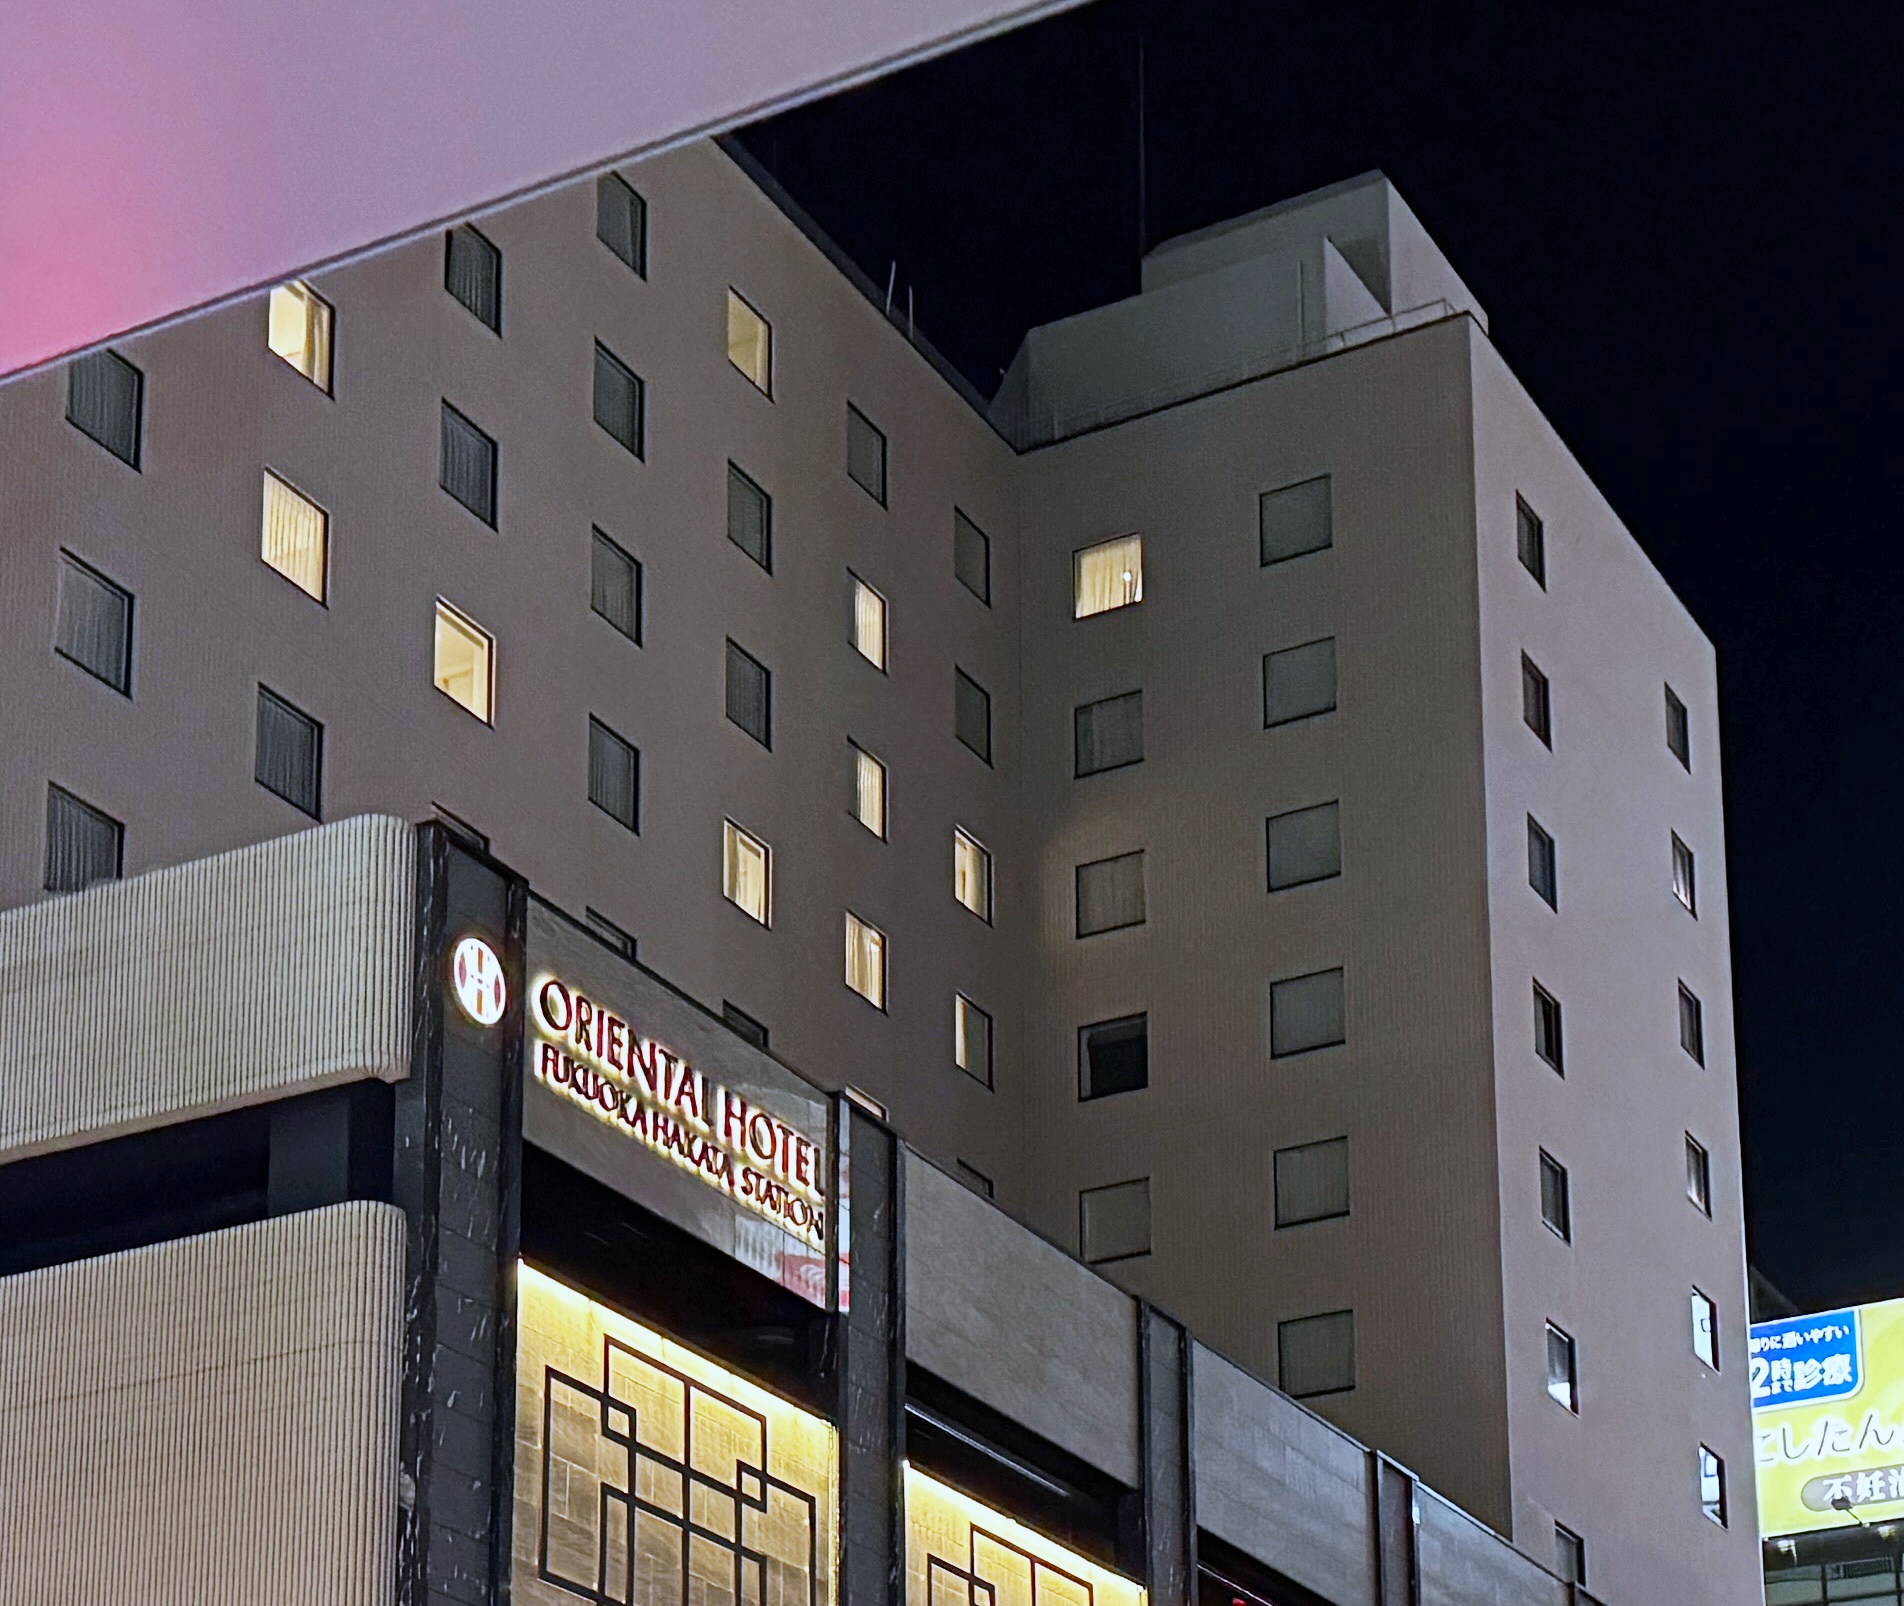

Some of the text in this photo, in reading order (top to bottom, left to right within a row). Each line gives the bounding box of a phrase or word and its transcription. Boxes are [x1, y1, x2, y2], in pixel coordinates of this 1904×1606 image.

[539, 980, 826, 1197] ORIENTAL HOTEL
[541, 1043, 825, 1241] FUKUOKA HAKATA STATION
